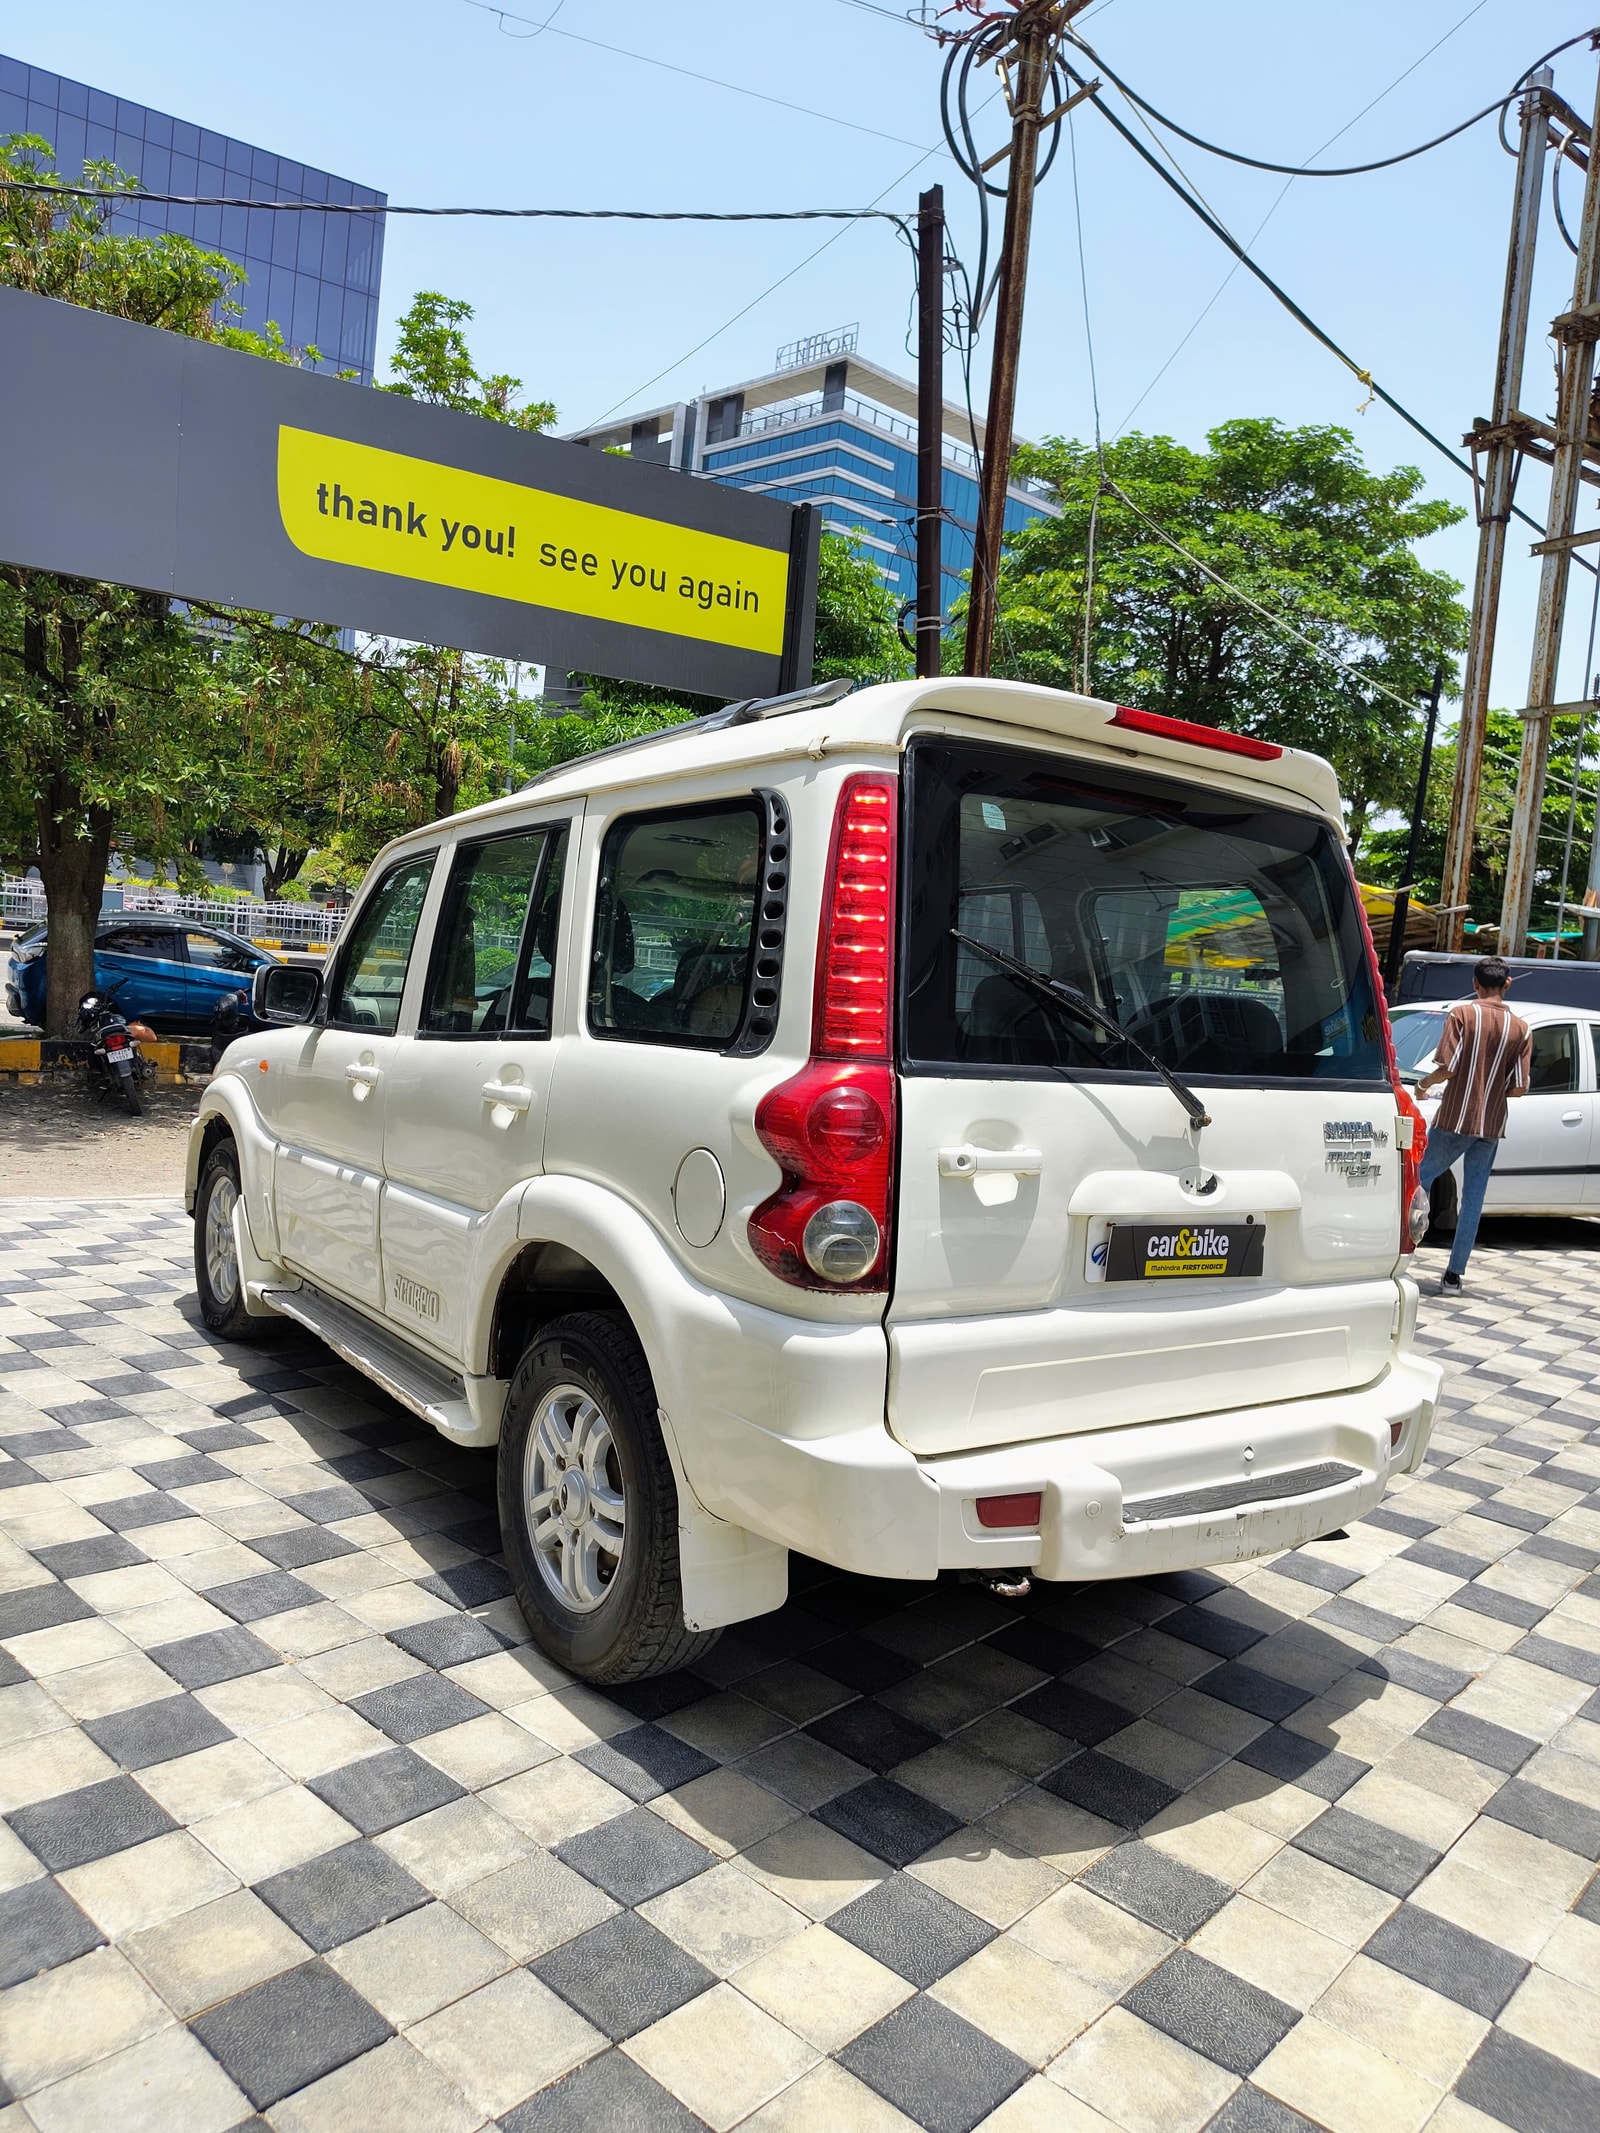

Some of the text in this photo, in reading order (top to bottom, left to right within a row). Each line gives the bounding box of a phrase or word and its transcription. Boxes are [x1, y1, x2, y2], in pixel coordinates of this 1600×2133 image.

[317, 483, 759, 613] thank you! see you again
[1147, 1228, 1229, 1257] car&bike
[1182, 1263, 1201, 1271] FIRST
[1201, 1263, 1223, 1271] CHOICE
